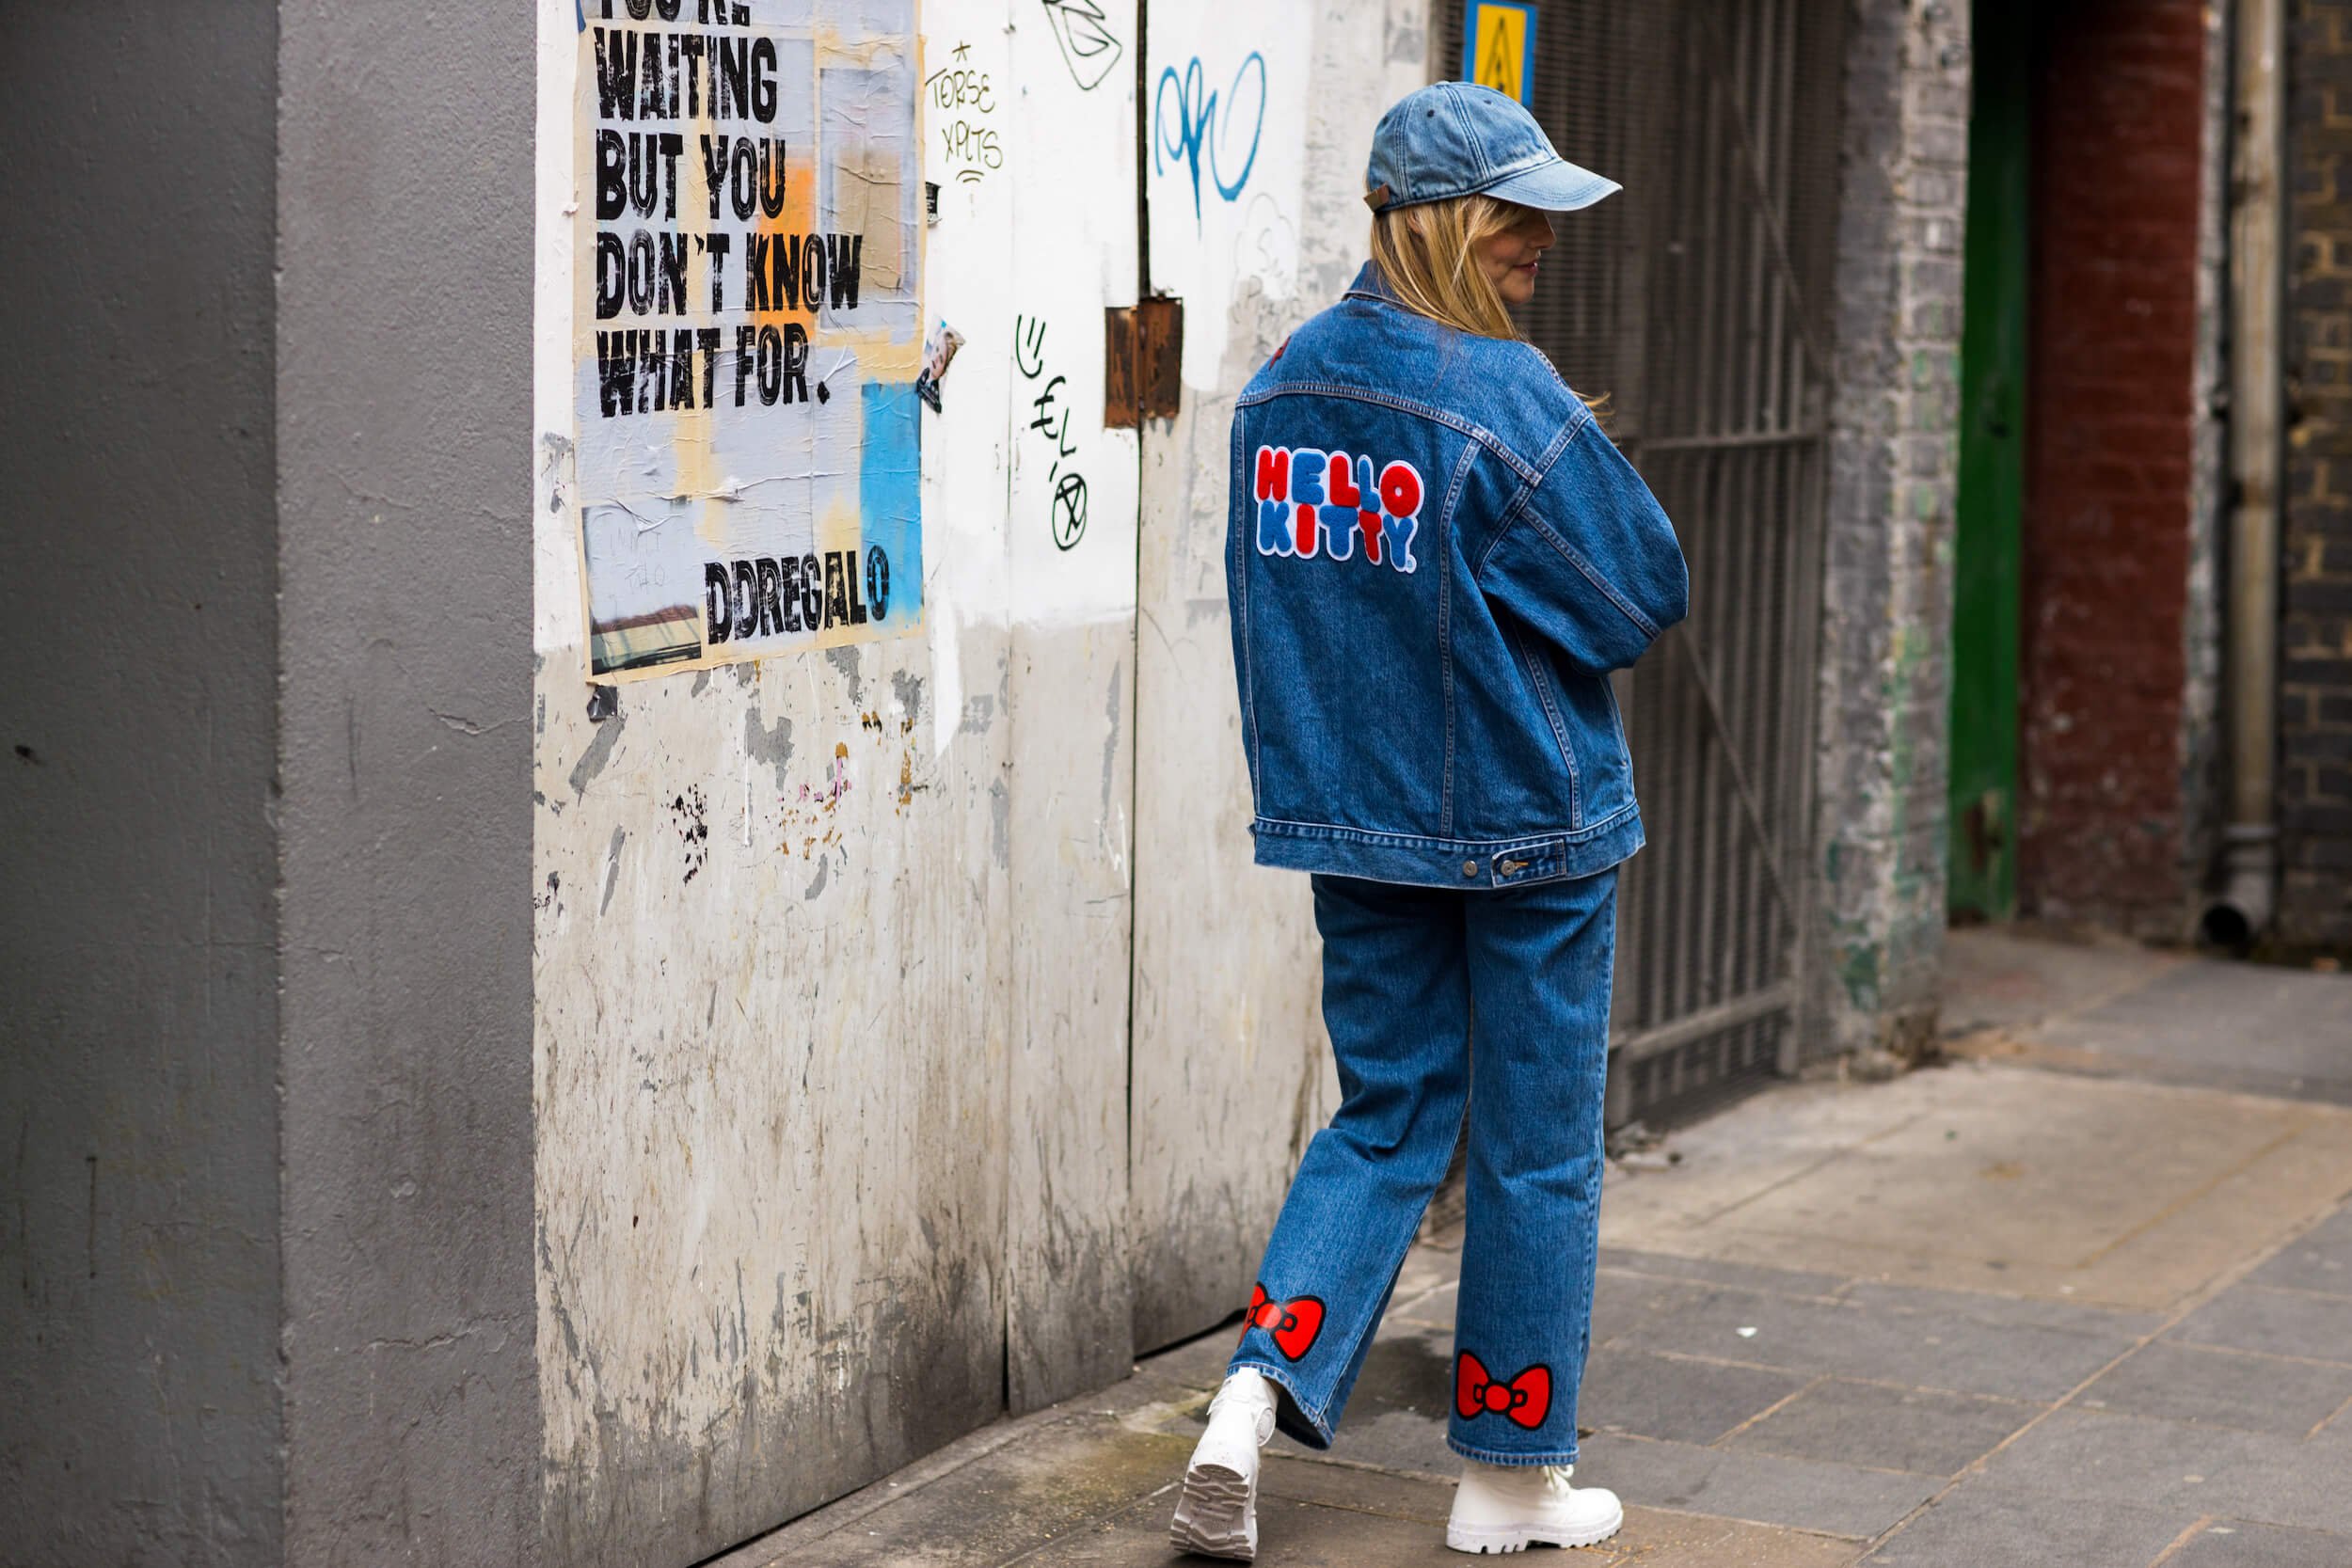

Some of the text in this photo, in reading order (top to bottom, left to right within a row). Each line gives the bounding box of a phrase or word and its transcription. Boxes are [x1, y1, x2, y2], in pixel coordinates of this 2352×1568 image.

[595, 27, 778, 123] WAITING
[596, 129, 787, 222] BUT YOU
[596, 229, 864, 320] DON'T KNOW
[596, 323, 831, 418] WHAT FOR.
[1255, 446, 1423, 517] HELLO
[1257, 499, 1418, 573] KITTY
[705, 544, 890, 645] DDREGALO
